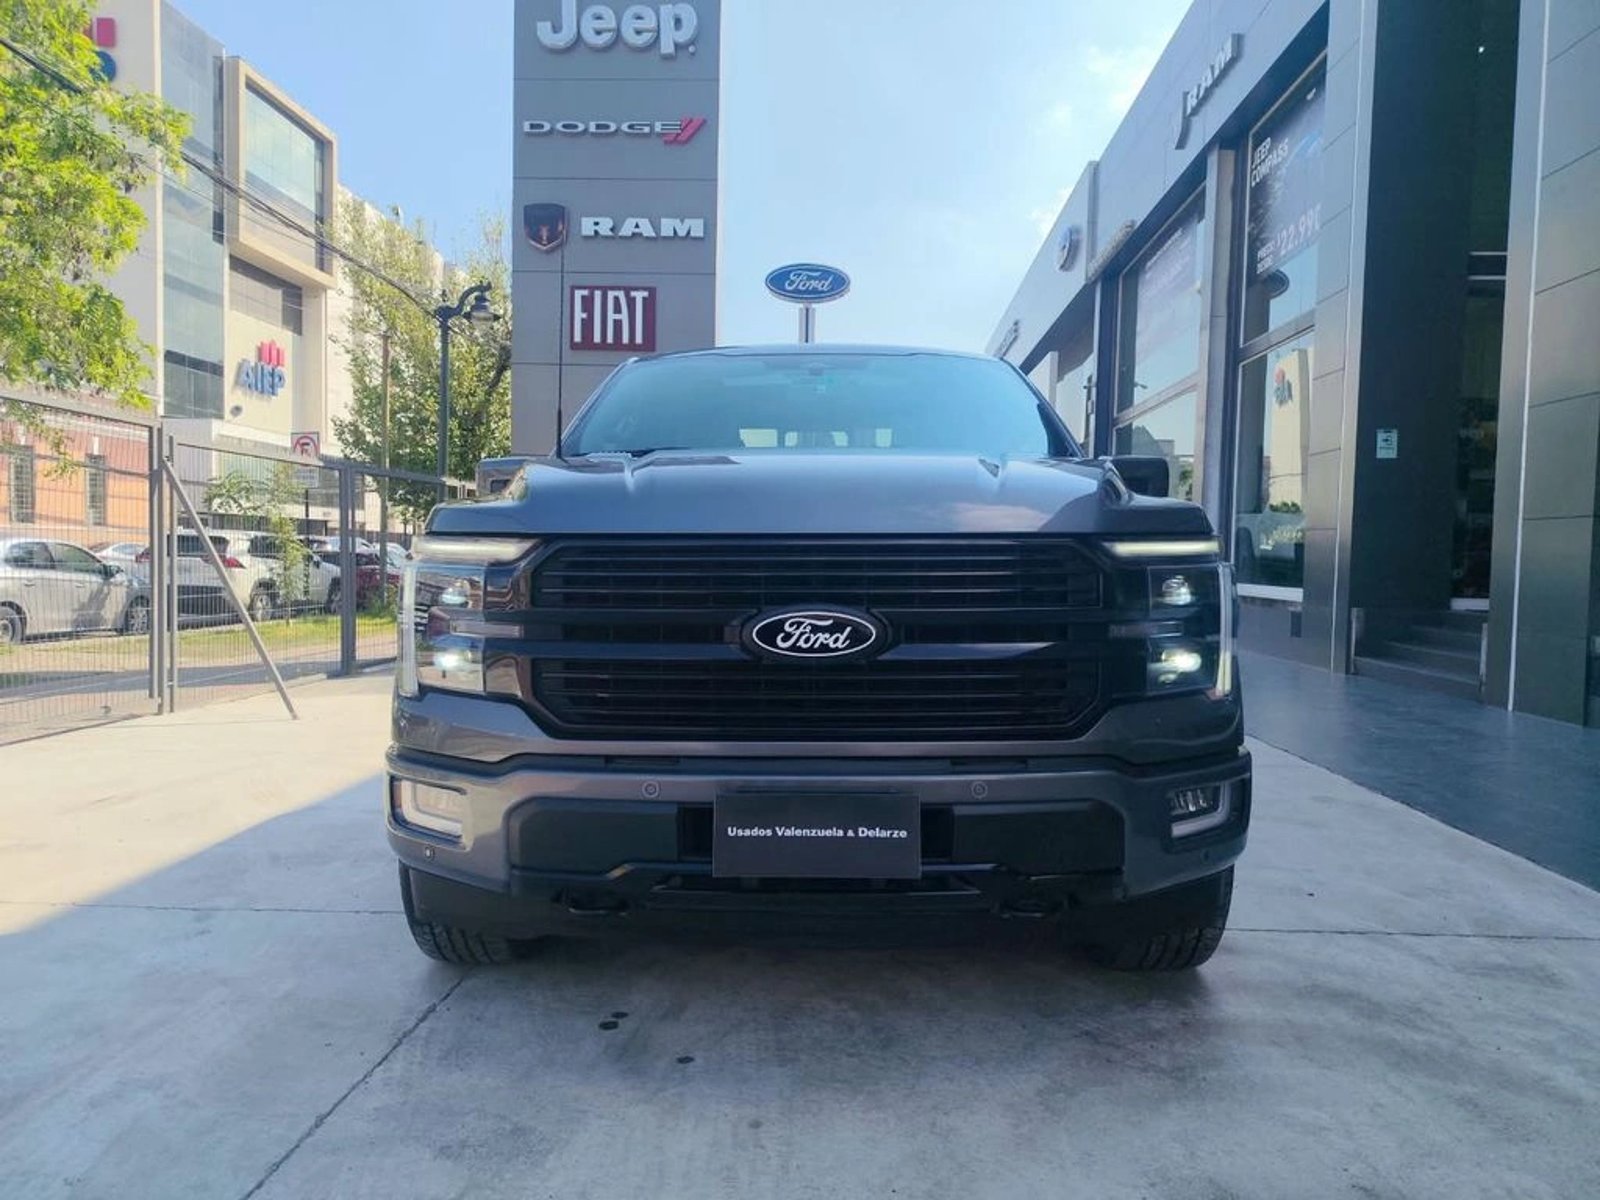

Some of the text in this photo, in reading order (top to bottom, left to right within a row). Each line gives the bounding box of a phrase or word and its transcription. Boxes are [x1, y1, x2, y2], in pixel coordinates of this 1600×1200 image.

[523, 120, 683, 134] DODGE
[1251, 138, 1289, 188] COMPASS
[1252, 137, 1271, 169] JEEP
[580, 217, 705, 238] RAM
[785, 271, 834, 291] Ford
[573, 290, 649, 345] FIAT
[238, 359, 286, 396] AIEP
[776, 617, 852, 649] Ford
[727, 826, 773, 837] Usados
[775, 826, 844, 837] Valenzuela
